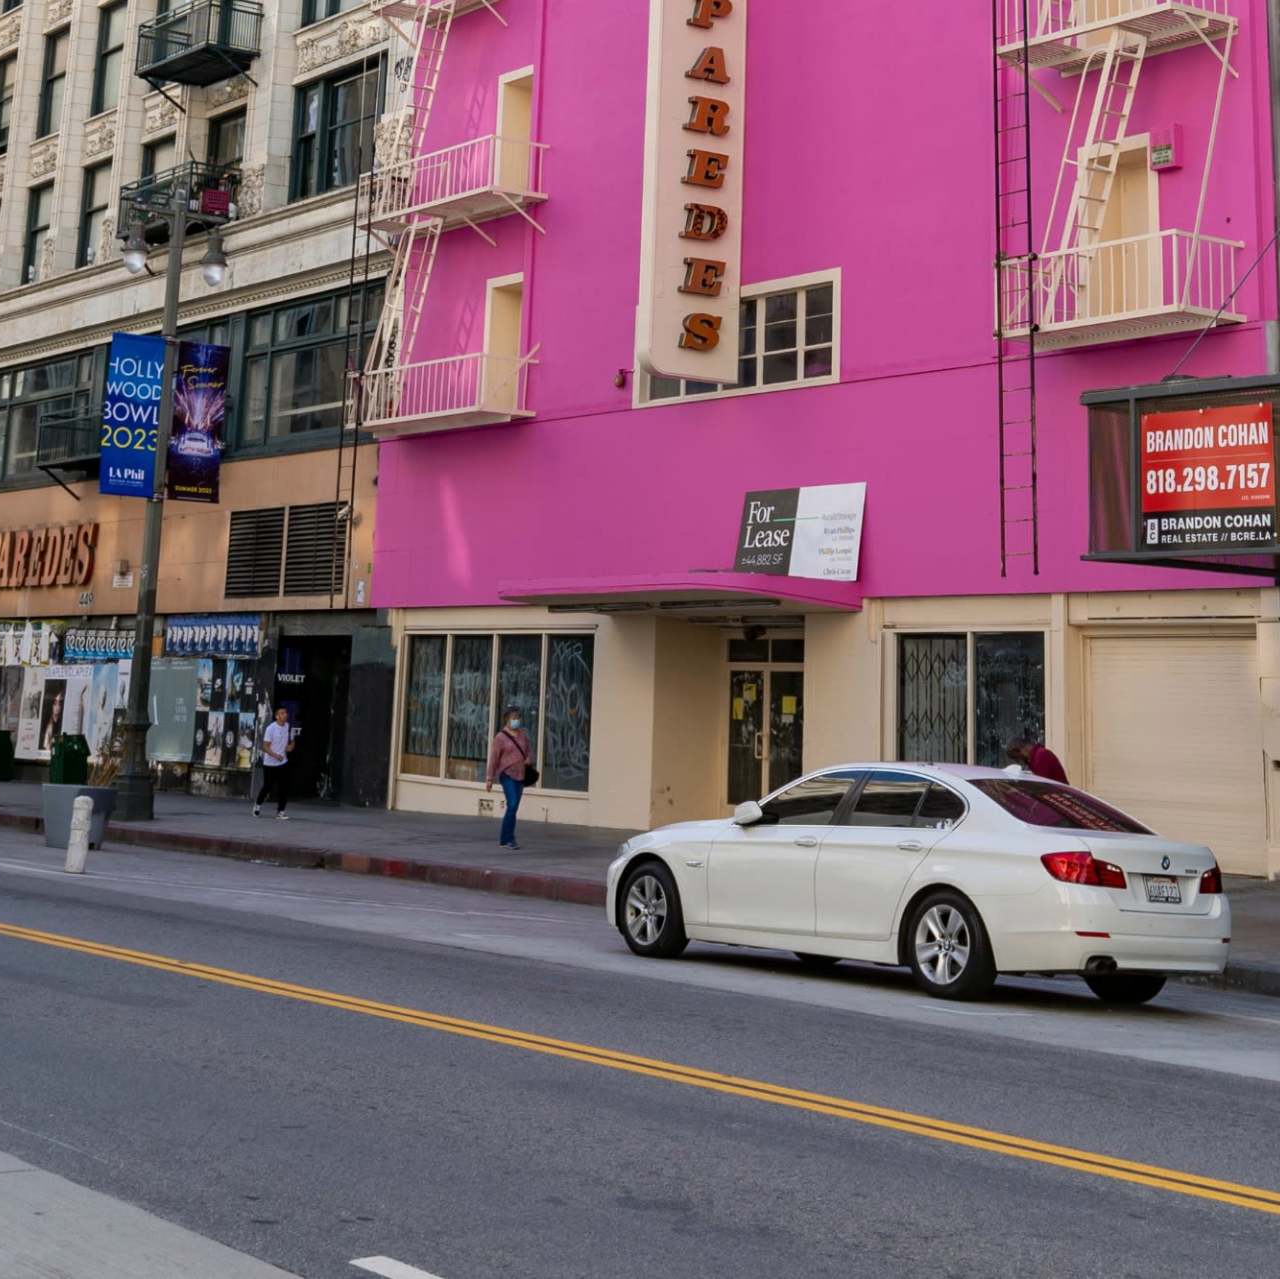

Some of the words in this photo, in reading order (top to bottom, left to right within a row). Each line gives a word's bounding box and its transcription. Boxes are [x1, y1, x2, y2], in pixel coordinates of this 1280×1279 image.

[106, 381, 162, 401] WOOD
[101, 424, 159, 452] 2023
[1146, 426, 1214, 453] BRANDON
[1218, 422, 1269, 448] COHAN
[124, 468, 145, 481] Phil
[1146, 463, 1270, 495] 818.298.7157
[748, 501, 775, 524] For
[1161, 516, 1222, 531] BRANDON
[1224, 514, 1271, 528] COHAN
[744, 525, 790, 548] Lease
[1161, 534, 1183, 543] REAL
[1185, 533, 1218, 543] ESTATE
[1231, 532, 1271, 541] BCRE.LA
[278, 672, 306, 683] VIOLET
